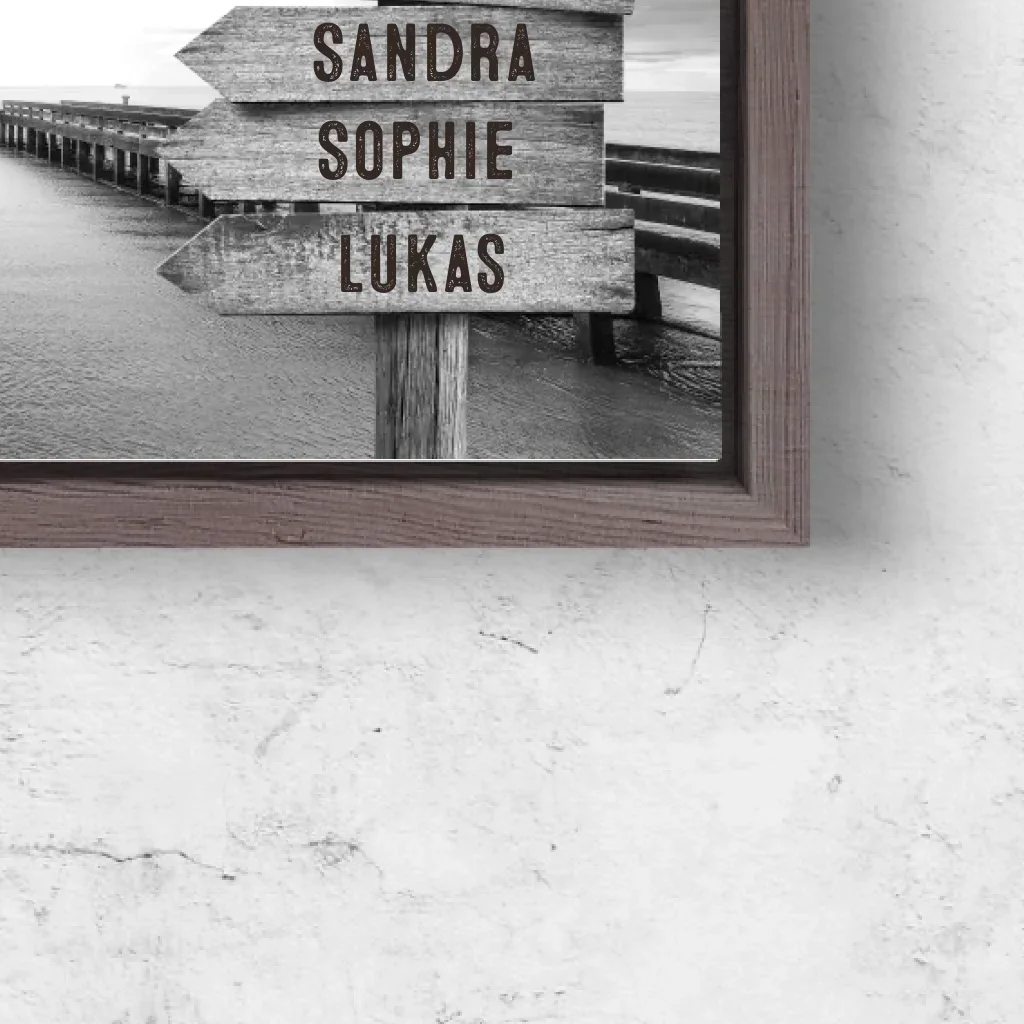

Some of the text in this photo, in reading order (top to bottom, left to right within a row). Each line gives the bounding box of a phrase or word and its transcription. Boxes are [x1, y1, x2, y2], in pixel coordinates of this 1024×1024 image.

[313, 22, 535, 82] SANDRA
[318, 121, 513, 180] SOPHIE
[340, 234, 505, 293] LUKAS
